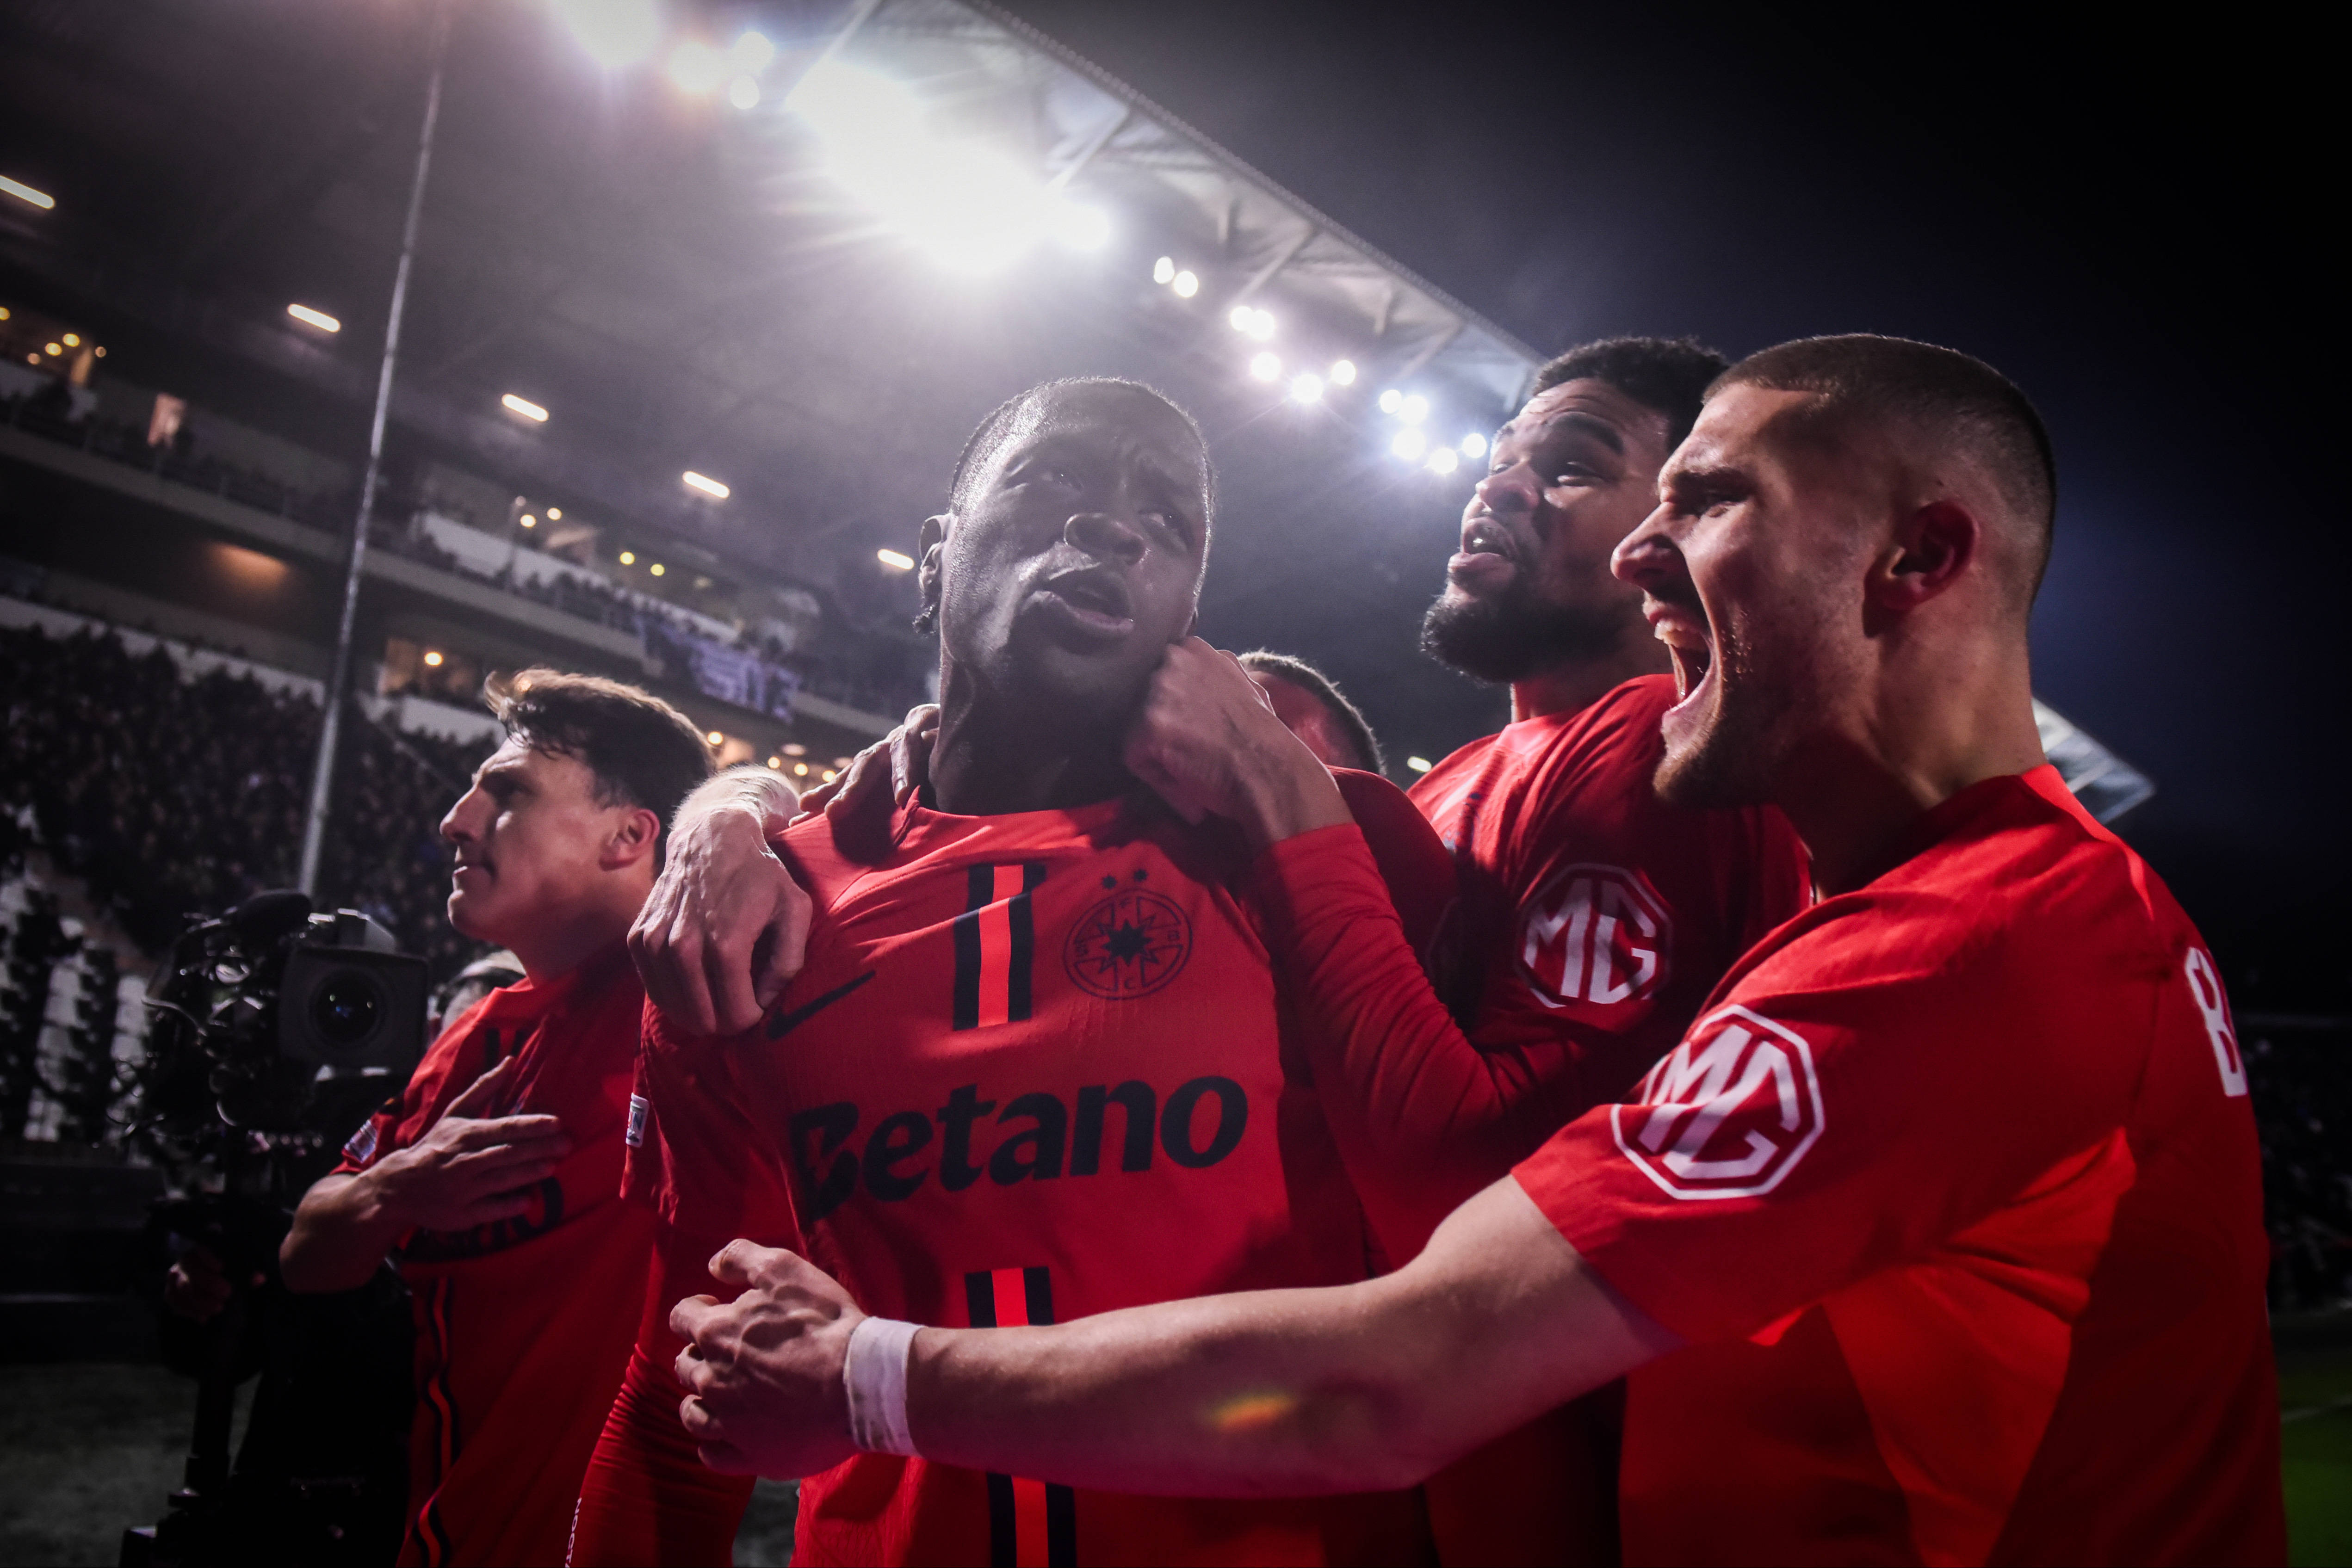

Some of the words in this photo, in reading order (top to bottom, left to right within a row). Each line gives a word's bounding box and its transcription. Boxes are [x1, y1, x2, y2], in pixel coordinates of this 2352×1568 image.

[1523, 878, 1657, 1004] MG
[788, 1075, 1249, 1226] Betano
[1637, 1024, 1801, 1179] MG
[565, 1497, 582, 1568] NOCT
